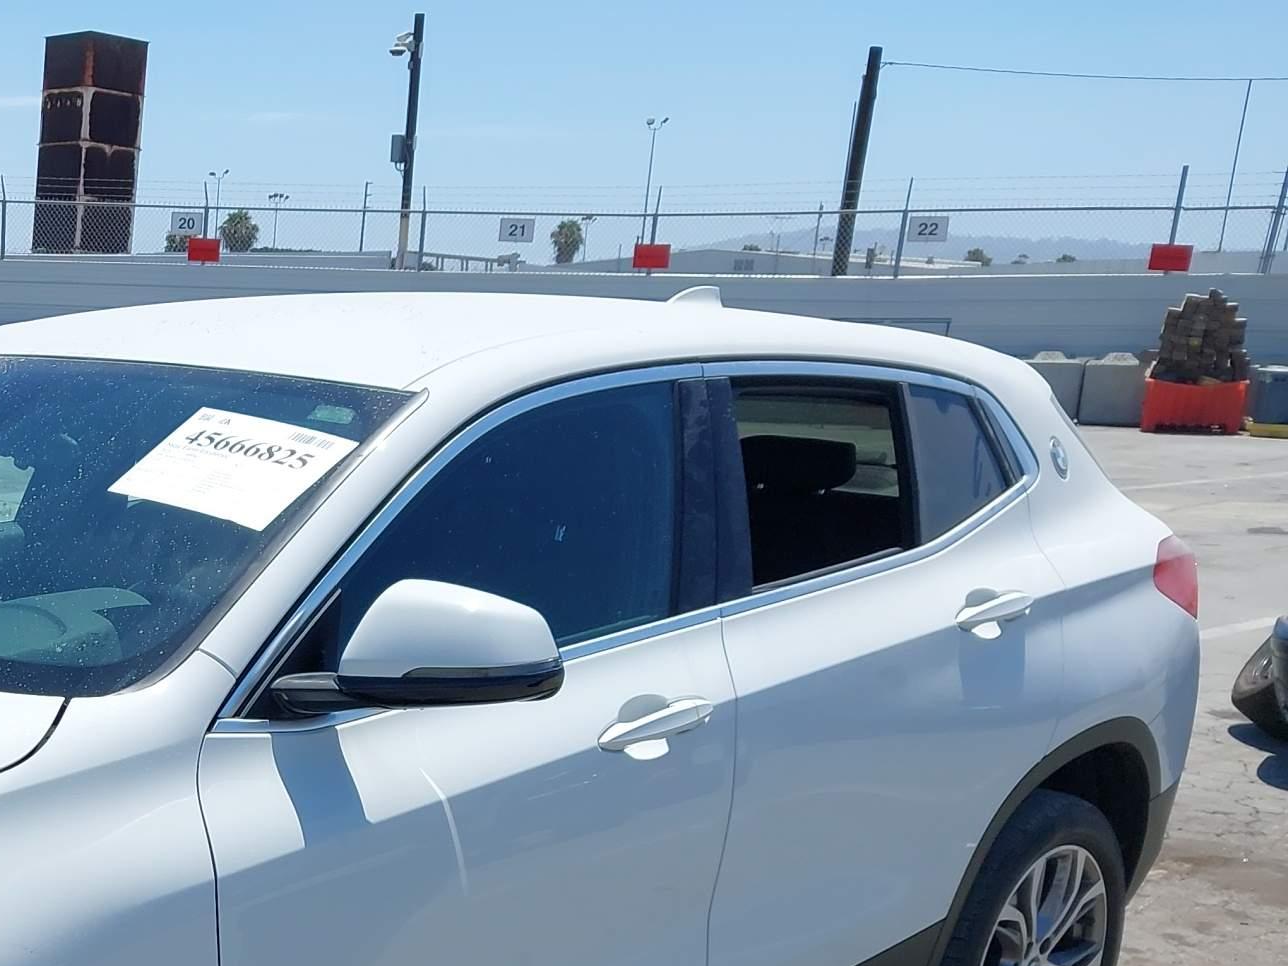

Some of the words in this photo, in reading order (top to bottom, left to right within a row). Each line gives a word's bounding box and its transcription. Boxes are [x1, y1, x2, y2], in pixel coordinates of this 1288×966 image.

[178, 217, 195, 230] 20
[508, 223, 526, 237] 21
[917, 222, 938, 236] 22
[185, 429, 315, 470] 45666825
